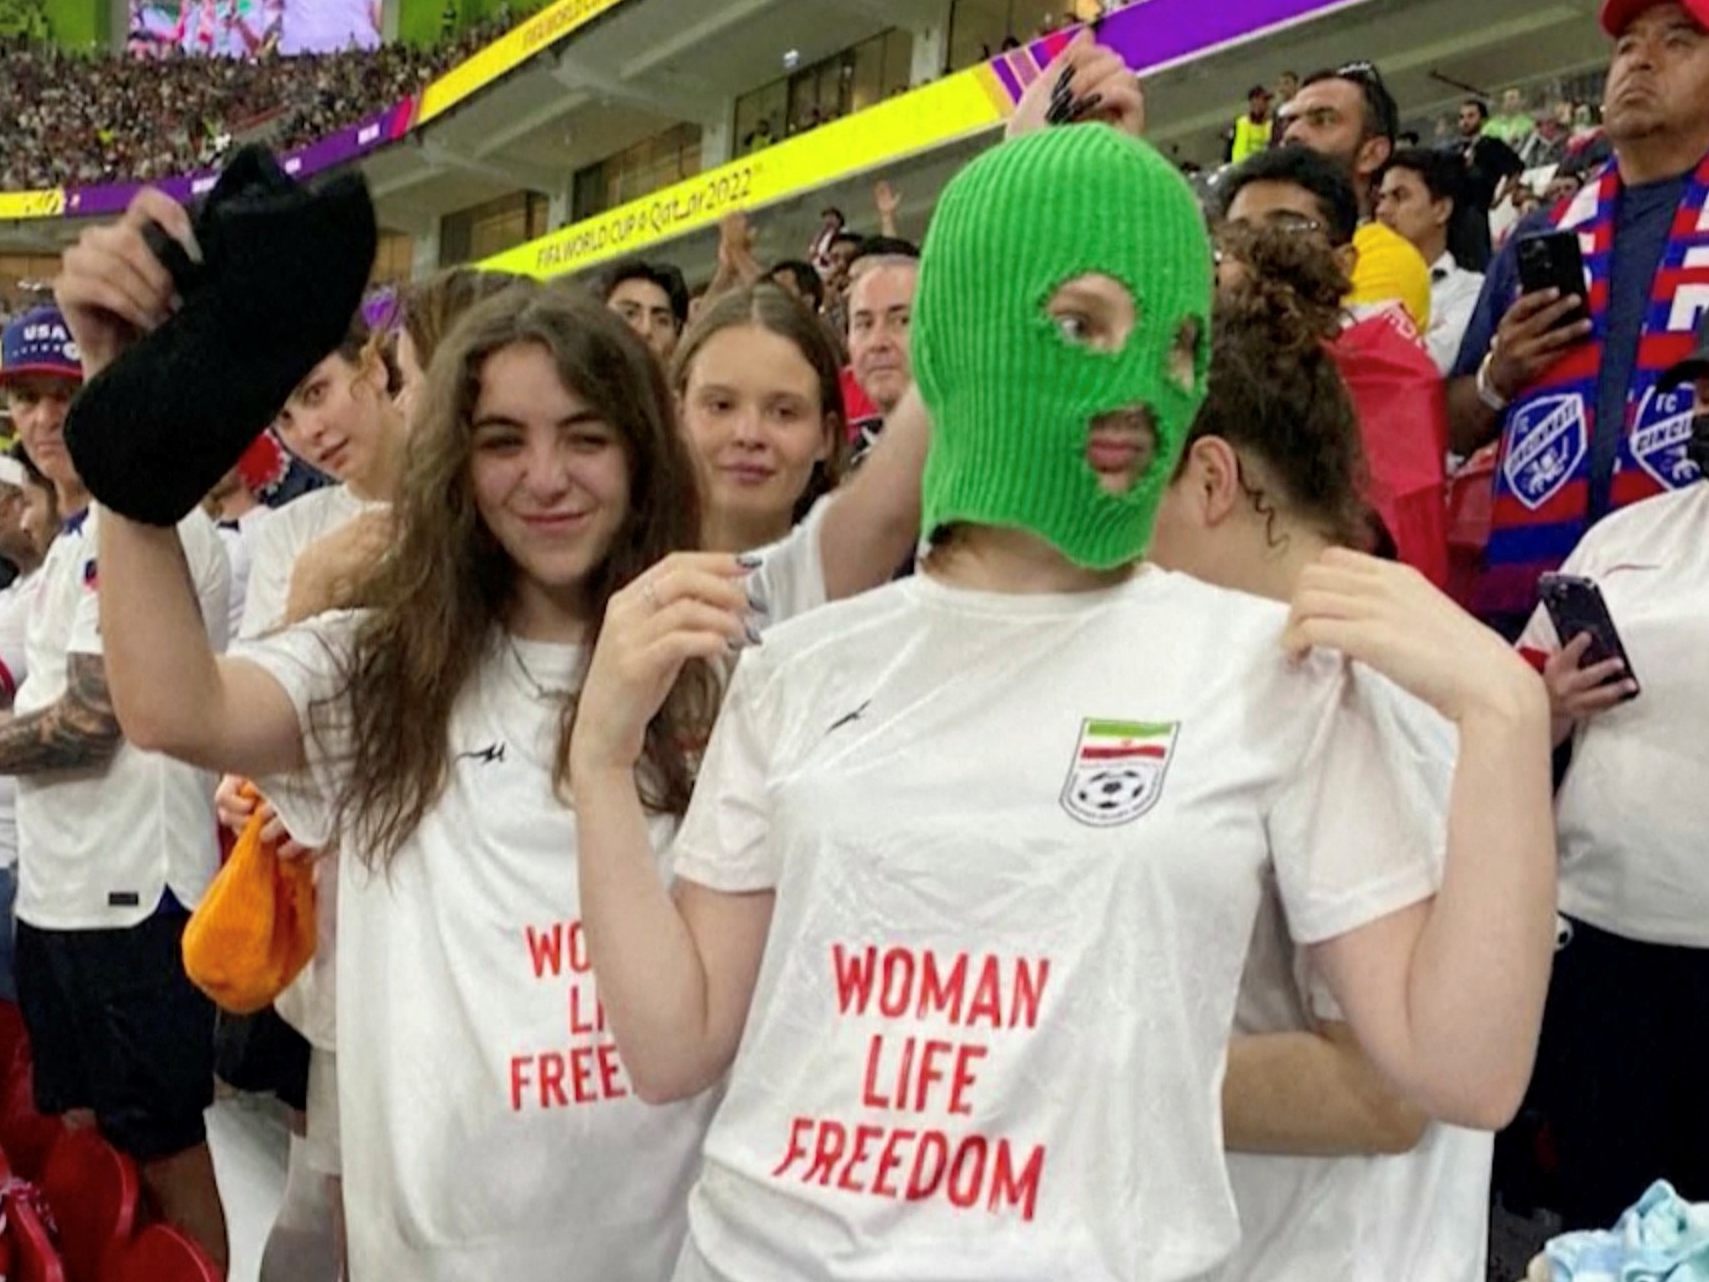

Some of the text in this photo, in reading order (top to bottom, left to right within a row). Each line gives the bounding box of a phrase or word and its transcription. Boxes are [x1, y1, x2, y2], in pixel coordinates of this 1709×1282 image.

[536, 243, 561, 269] FIFA
[563, 226, 607, 262] WORLD
[610, 214, 635, 243] CUP
[23, 324, 67, 341] USA
[1656, 393, 1677, 413] FC
[832, 943, 1050, 1029] WOMAN
[511, 1044, 628, 1112] FREE
[862, 1034, 988, 1115] LIFE
[772, 1117, 1046, 1222] FREEDOM
